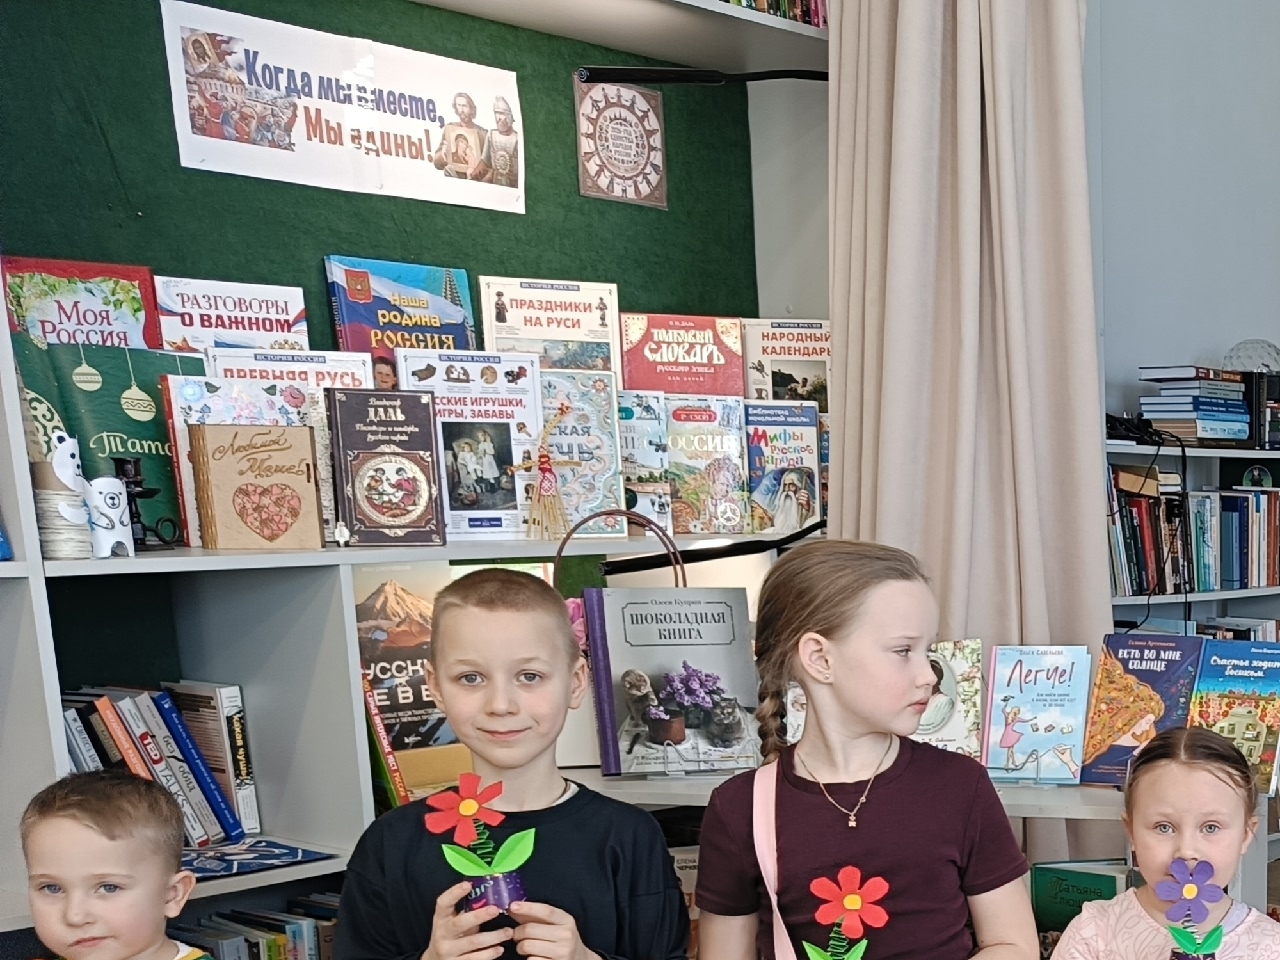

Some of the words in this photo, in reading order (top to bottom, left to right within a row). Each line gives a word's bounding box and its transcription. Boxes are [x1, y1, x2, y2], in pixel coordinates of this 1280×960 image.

[243, 49, 312, 98] Когда
[303, 105, 343, 146] Мы
[176, 292, 290, 316] РАЗГОВОРЫ
[391, 292, 428, 308] Наша
[509, 298, 592, 313] ПРАЗДНИКИ
[54, 301, 112, 326] Моя
[378, 310, 441, 327] родина
[180, 312, 194, 327] О
[200, 314, 293, 333] ВАЖНОМ
[524, 316, 543, 327] НА
[547, 317, 581, 329] РУСИ
[371, 329, 454, 349] РОССИЯ
[643, 342, 726, 364] СЛОВАРЬ
[315, 370, 363, 387] РУСЬ
[470, 397, 526, 409] ИГРУШКИ,
[470, 409, 515, 419] ЗАБАВЫ
[750, 427, 804, 447] Мифы
[630, 612, 726, 626] ШОКОЛАДНАЯ
[658, 628, 704, 640] КНИГА
[1118, 649, 1140, 659] ЕСТЬ
[1144, 650, 1156, 660] ВО
[1159, 651, 1182, 661] МНЕ
[1128, 659, 1167, 672] СОЛНЦЕ
[1006, 659, 1075, 694] Легче!
[145, 735, 162, 764] TED
[159, 765, 189, 810] TALKS
